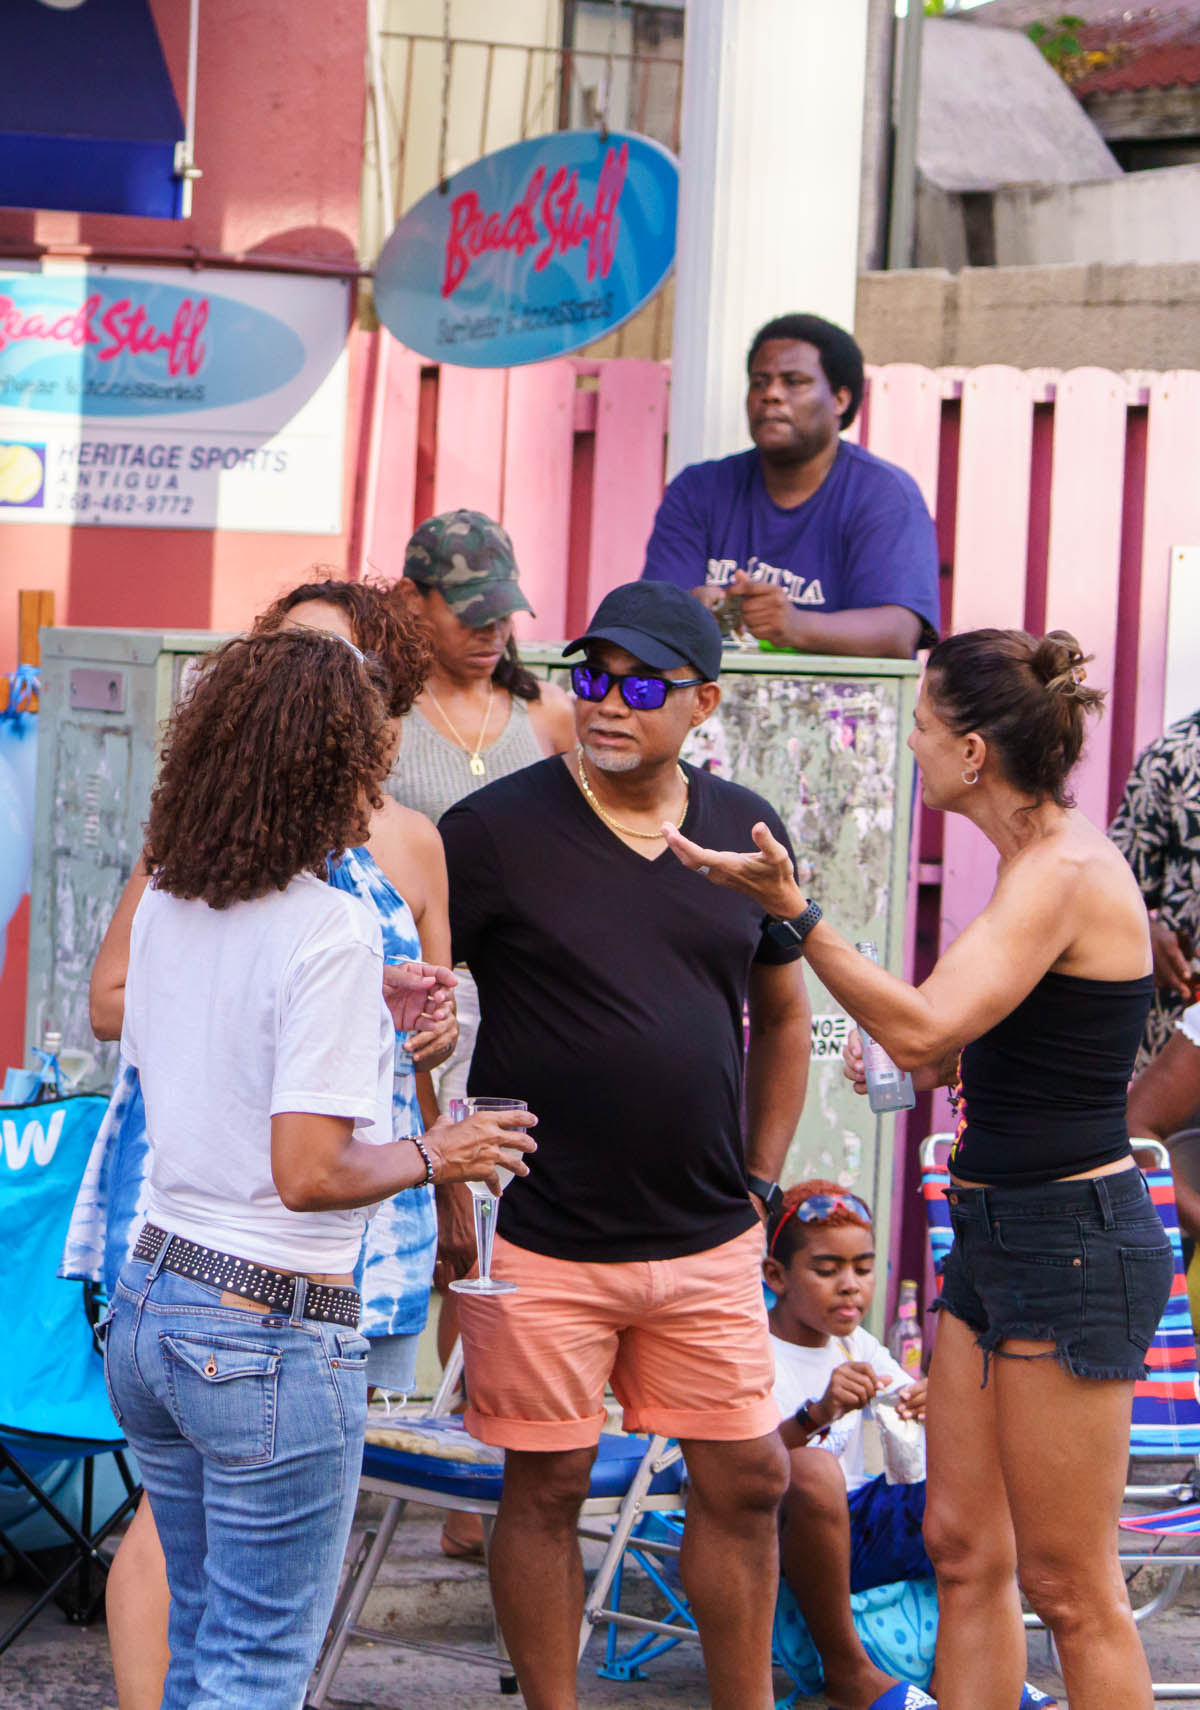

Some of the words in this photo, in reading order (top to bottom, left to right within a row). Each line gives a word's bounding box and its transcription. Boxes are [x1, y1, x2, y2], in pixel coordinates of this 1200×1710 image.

[441, 164, 546, 299] Beach
[534, 142, 629, 283] Stuff
[98, 297, 209, 376] Stuff
[58, 442, 183, 469] HERITAGE
[189, 447, 288, 473] SPORTS
[58, 470, 180, 489] ANTIGUA
